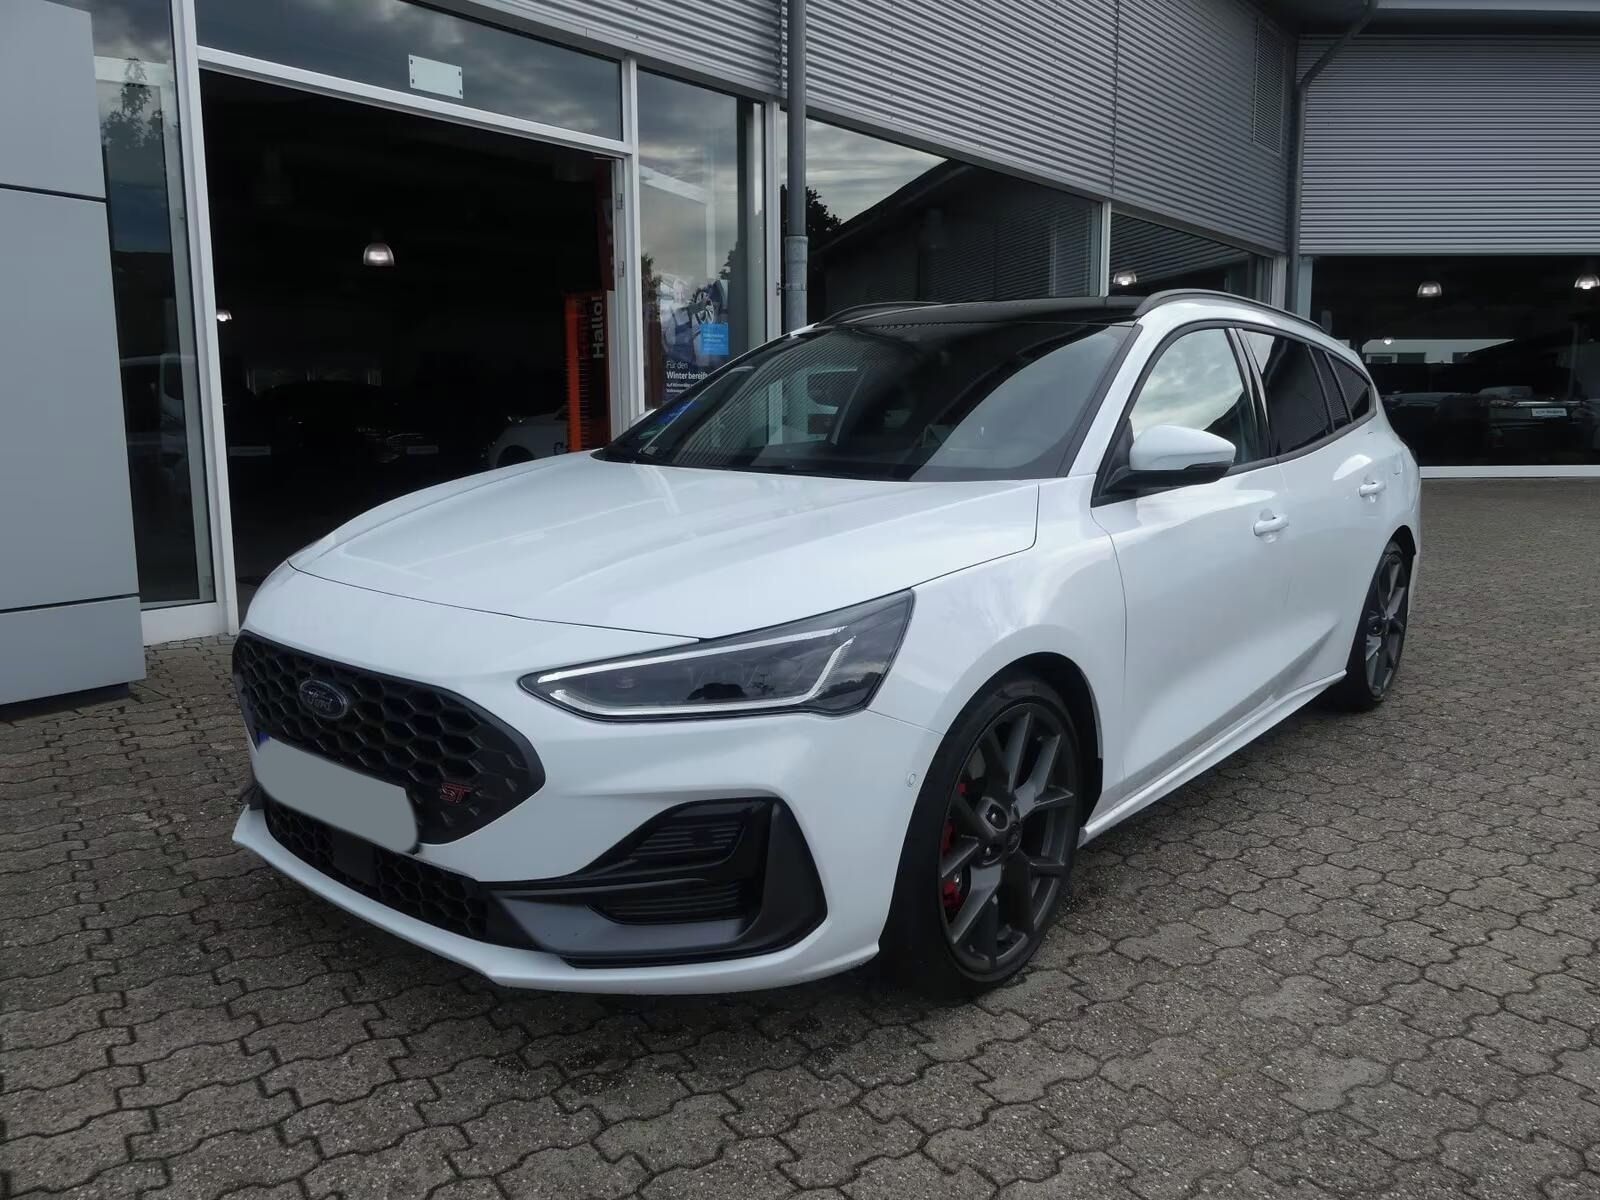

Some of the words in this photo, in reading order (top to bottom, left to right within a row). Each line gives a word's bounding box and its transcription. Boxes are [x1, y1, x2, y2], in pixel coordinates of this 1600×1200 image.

[592, 297, 604, 359] Hallo!
[677, 360, 688, 369] den
[666, 371, 687, 379] Winter
[440, 783, 471, 804] ST
